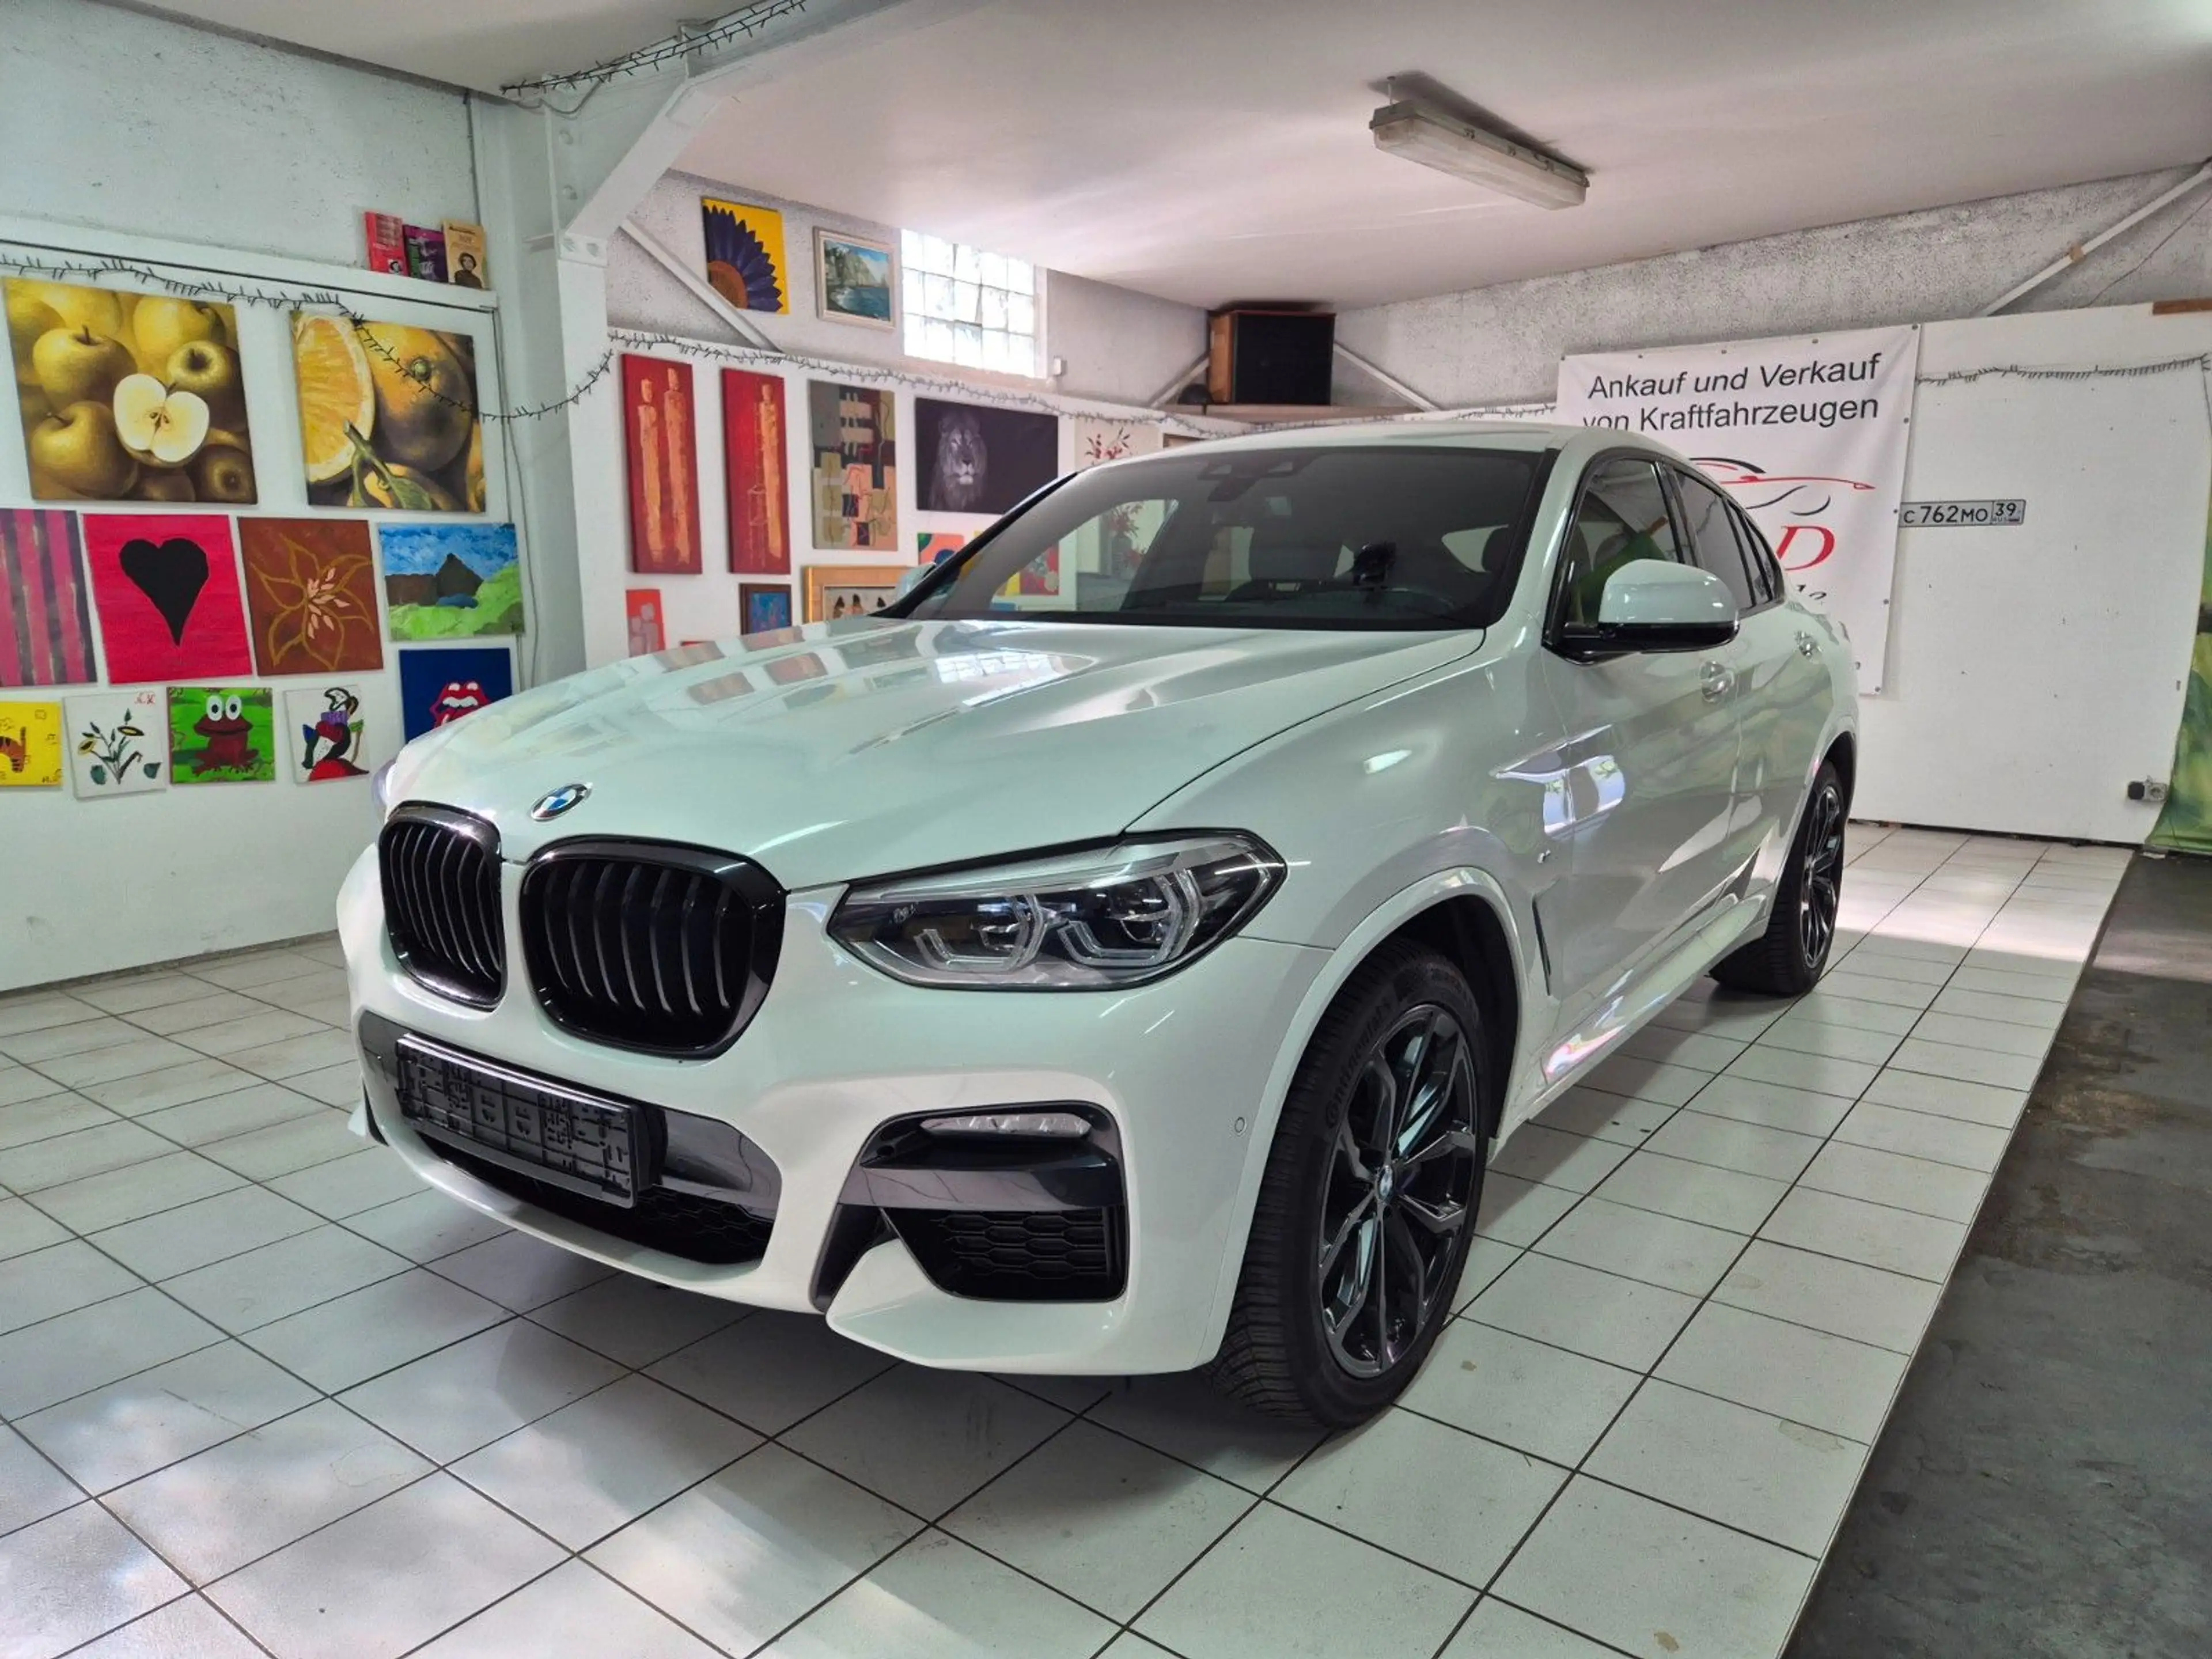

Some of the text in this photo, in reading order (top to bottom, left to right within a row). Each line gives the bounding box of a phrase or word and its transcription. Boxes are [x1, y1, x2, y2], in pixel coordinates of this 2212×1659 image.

[1588, 353, 1883, 399] Ankauf und Verkauf
[1641, 398, 1878, 431] Kraftfahrzeugen
